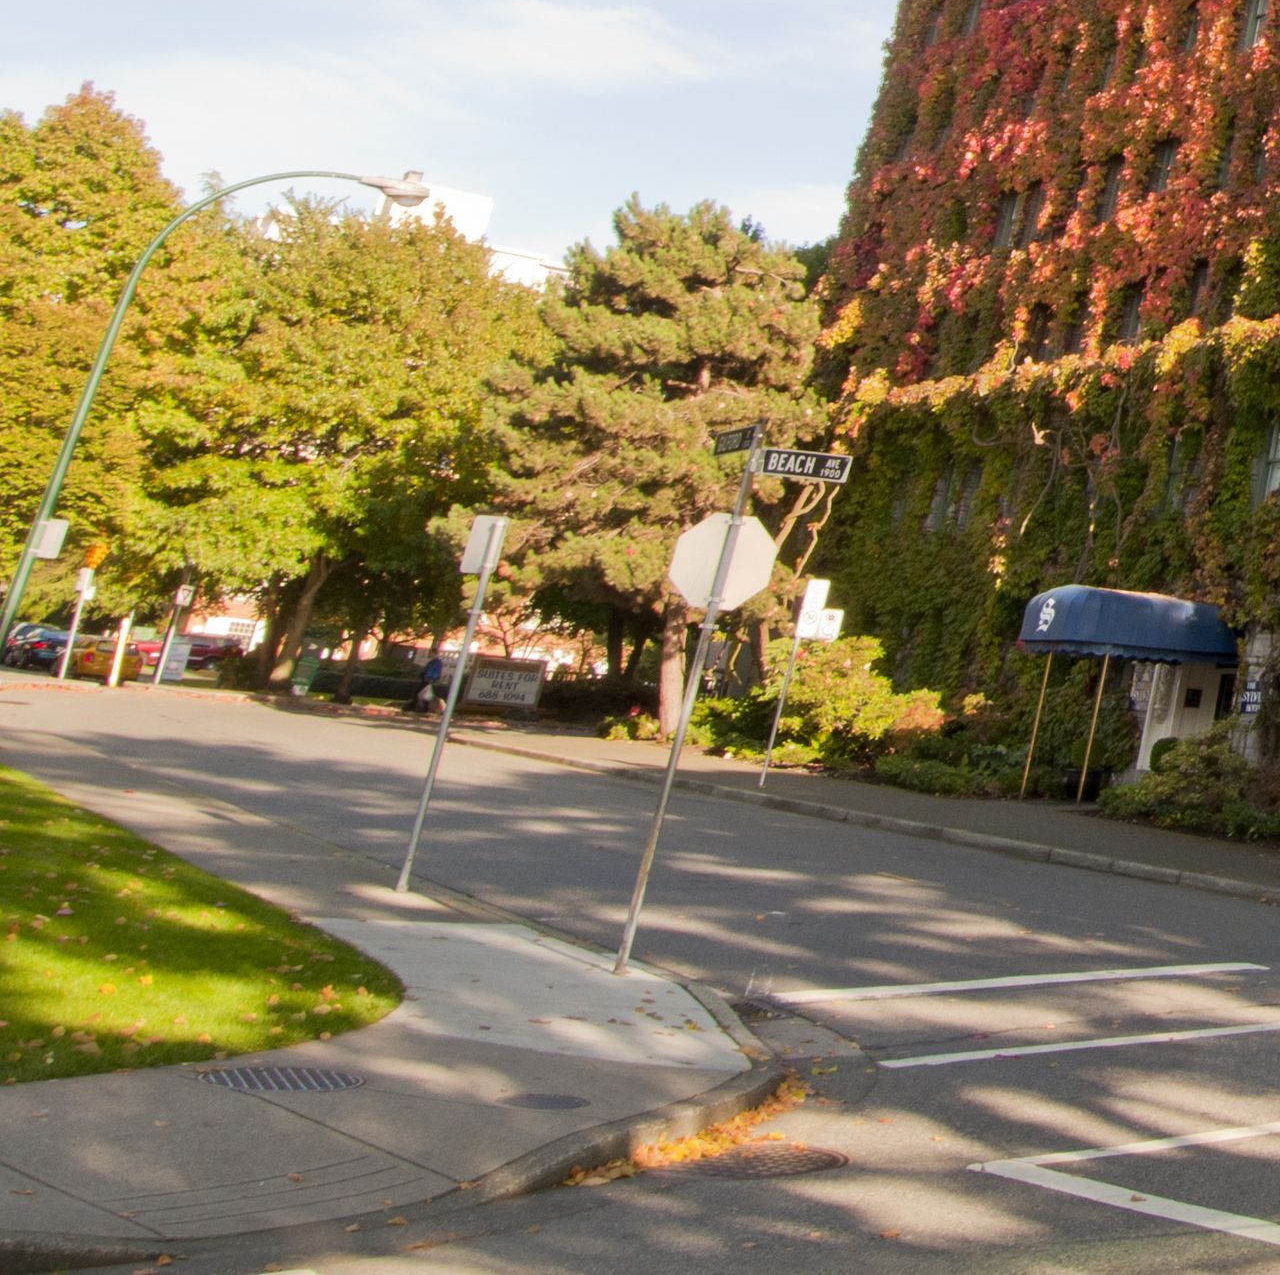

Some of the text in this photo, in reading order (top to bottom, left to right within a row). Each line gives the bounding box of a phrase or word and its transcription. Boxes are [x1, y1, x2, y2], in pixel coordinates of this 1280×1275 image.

[767, 453, 841, 474] BEACH AVE
[820, 468, 841, 478] 1900
[1036, 598, 1056, 632] S
[477, 668, 539, 682] SUITES FOR
[491, 680, 520, 690] RENT
